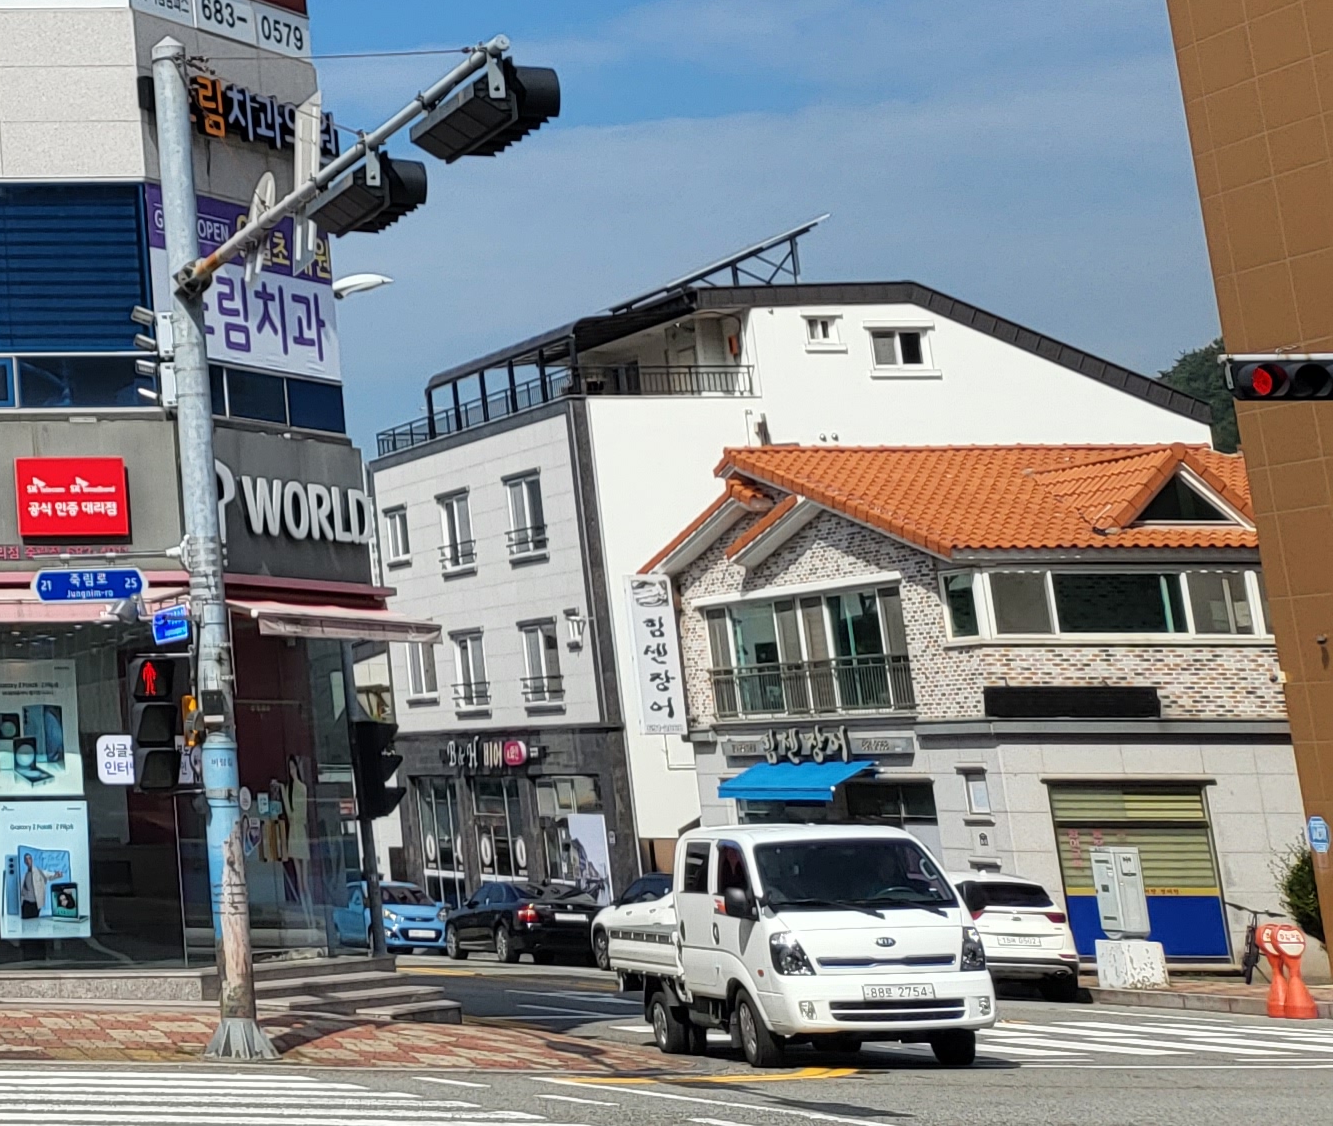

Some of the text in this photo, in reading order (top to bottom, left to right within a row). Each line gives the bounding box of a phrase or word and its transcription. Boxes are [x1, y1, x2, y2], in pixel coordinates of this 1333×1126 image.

[197, 220, 229, 243] OPEN
[28, 502, 117, 517] 공식 인증 대리점
[241, 476, 373, 544] WORLD
[41, 573, 138, 592] 21 죽림로 25
[67, 589, 114, 599] Jungnim-ro
[877, 938, 894, 946] KIA
[898, 986, 928, 996] 2754
